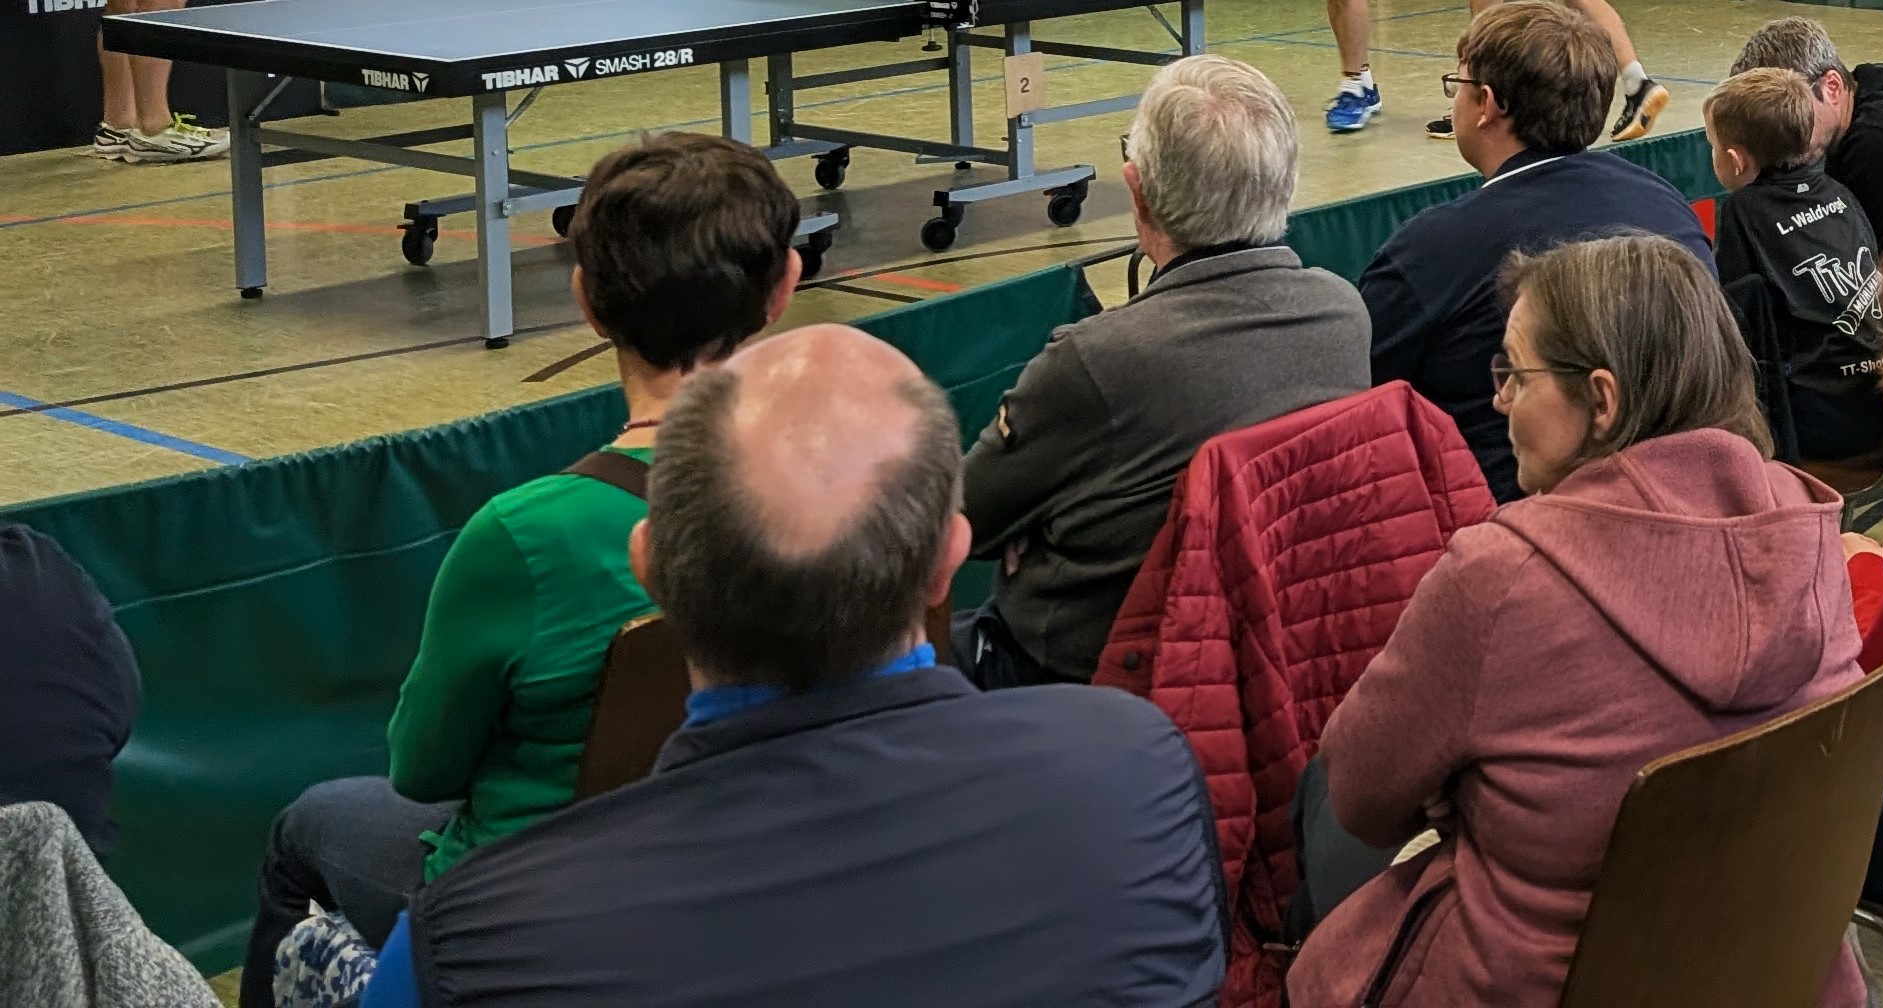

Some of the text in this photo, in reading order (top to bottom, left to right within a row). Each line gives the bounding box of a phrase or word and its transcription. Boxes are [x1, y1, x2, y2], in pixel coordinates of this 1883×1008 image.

[481, 48, 694, 90] TIBHAR SMASH 28/R
[361, 68, 410, 91] TIBHAR
[1020, 77, 1030, 93] 2
[1776, 221, 1794, 235] L.
